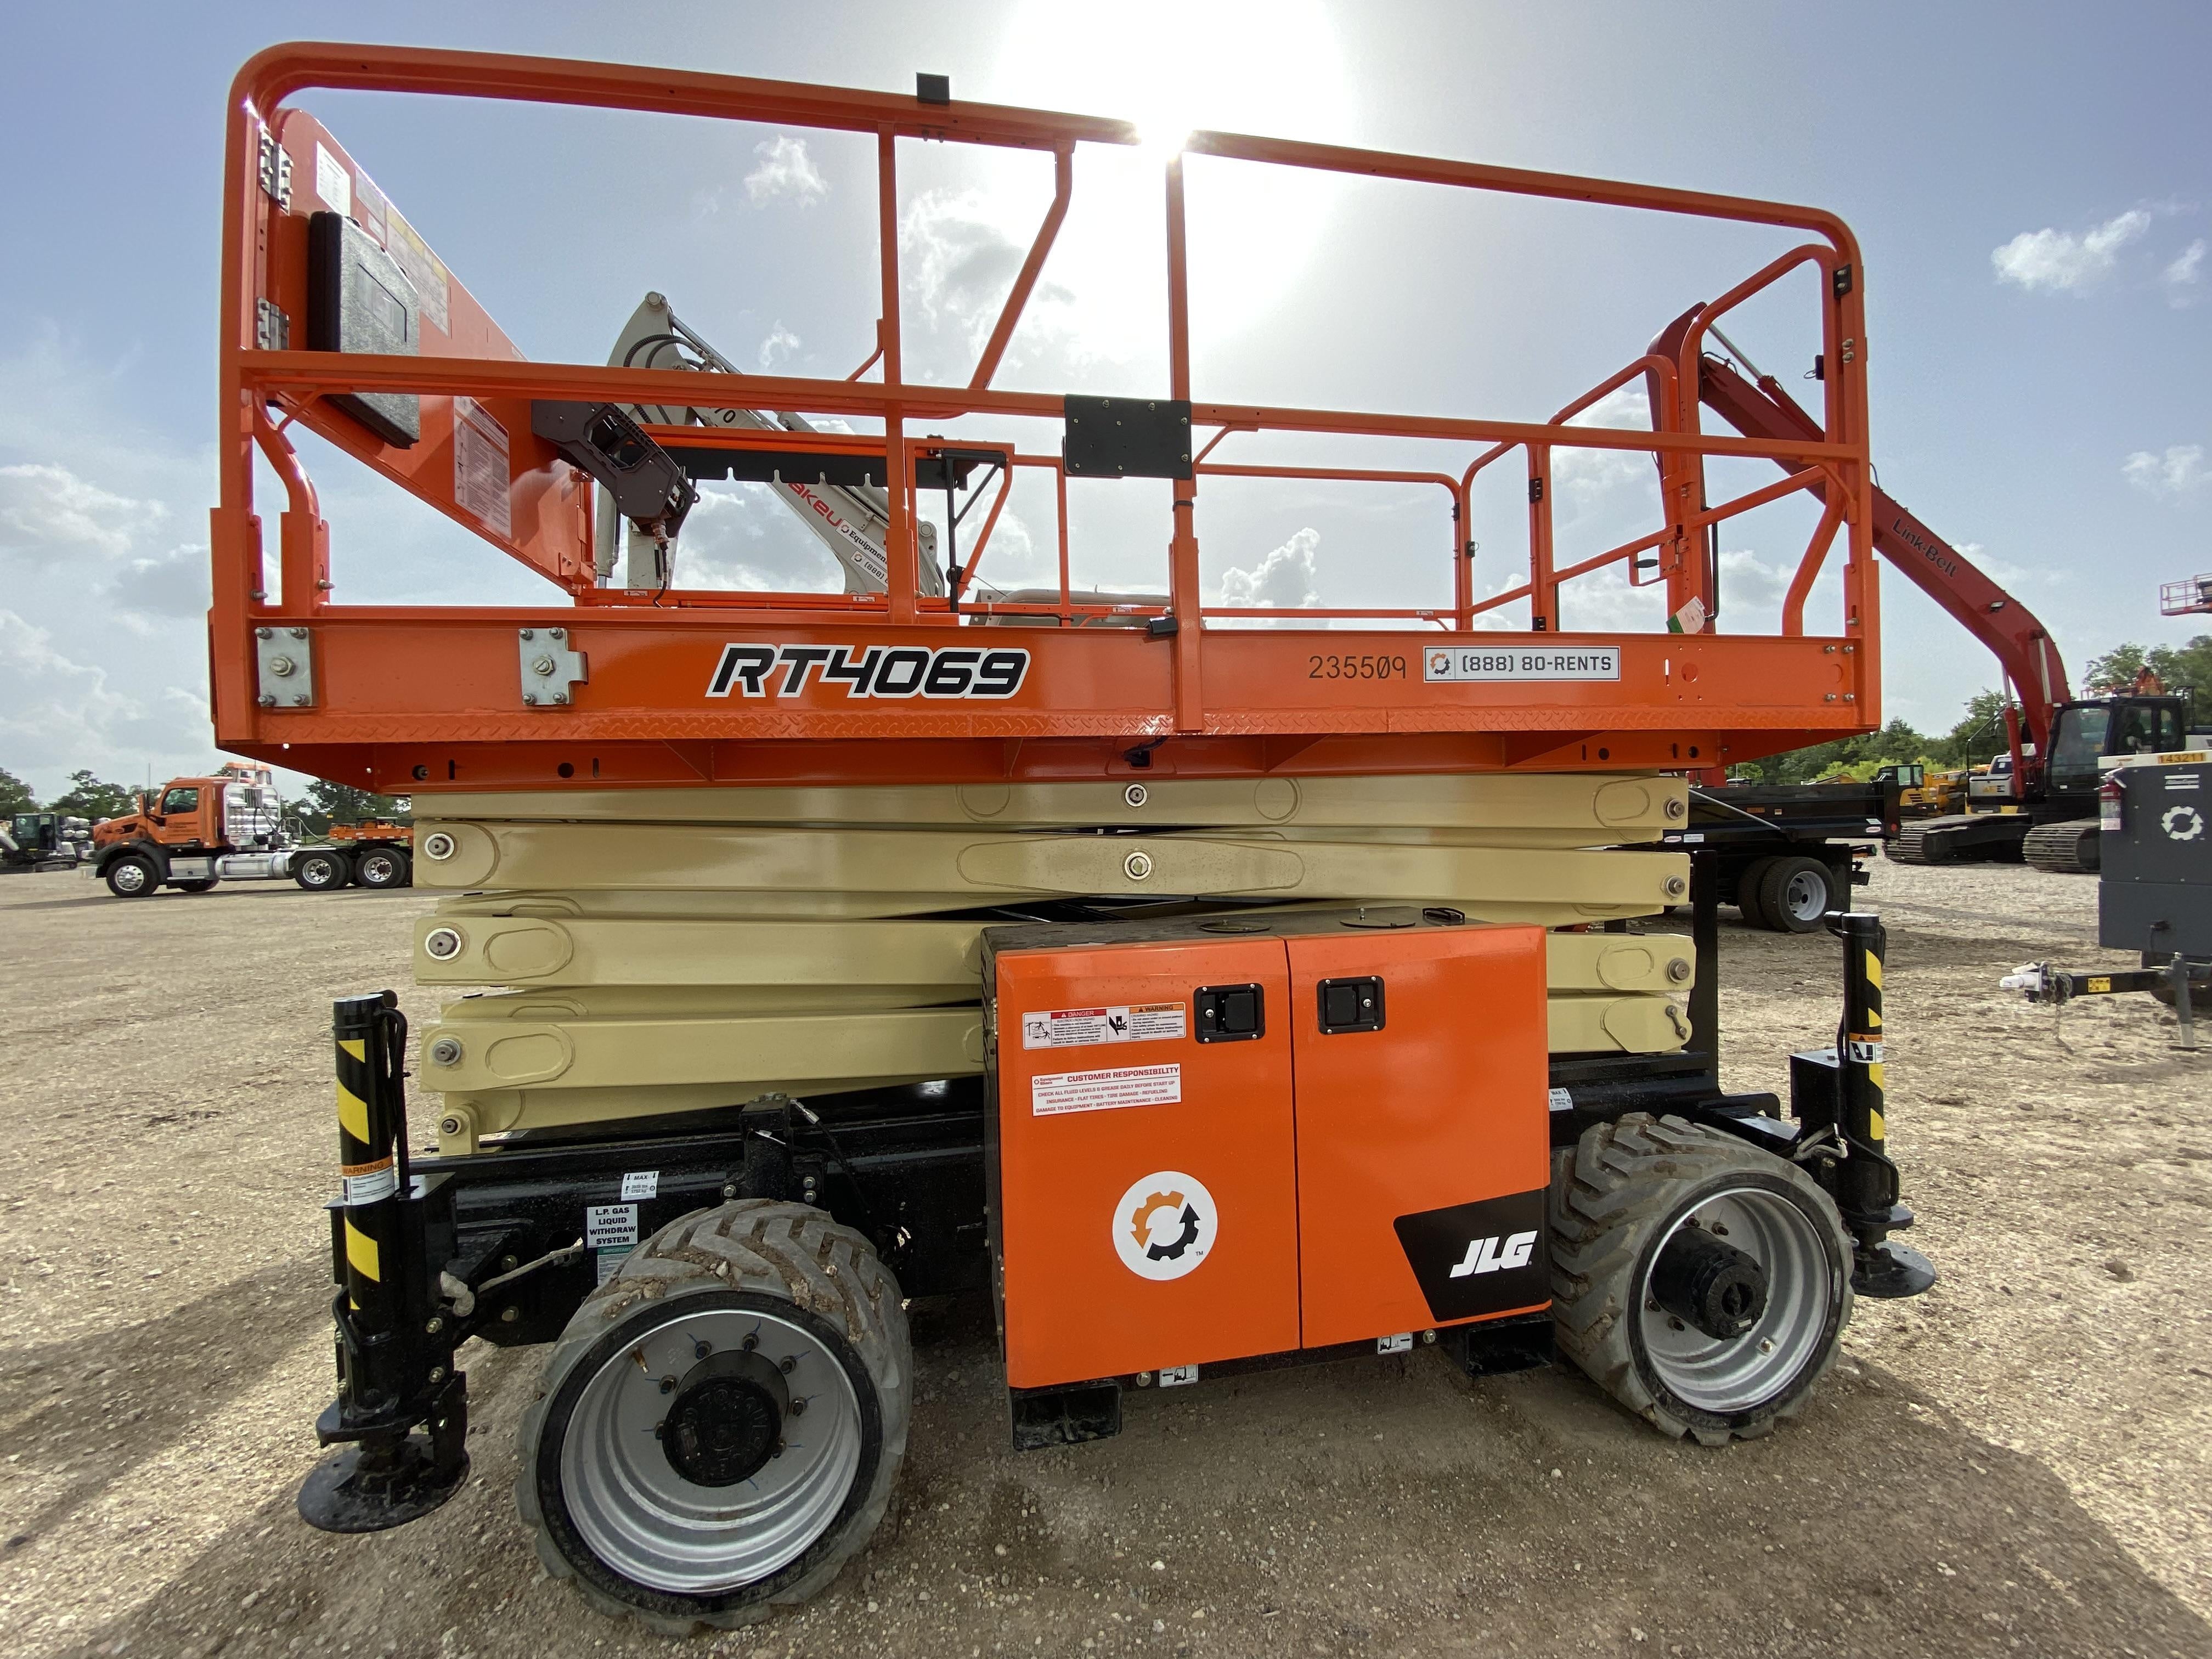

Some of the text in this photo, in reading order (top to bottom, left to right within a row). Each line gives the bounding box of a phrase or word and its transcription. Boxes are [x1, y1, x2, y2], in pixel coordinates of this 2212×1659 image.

[849, 530, 887, 565] Equipmen
[706, 644, 1030, 698] RT4069
[1308, 655, 1406, 679] 235509
[1521, 656, 1611, 672] 80-RENTS
[1067, 1066, 1179, 1082] CUSTOMER RESPONSIBILITY
[599, 1217, 627, 1226] LIQUID
[589, 1226, 636, 1235] WITHDRAW
[596, 1236, 630, 1244] SYSTEM
[1449, 1230, 1538, 1278] JLG
